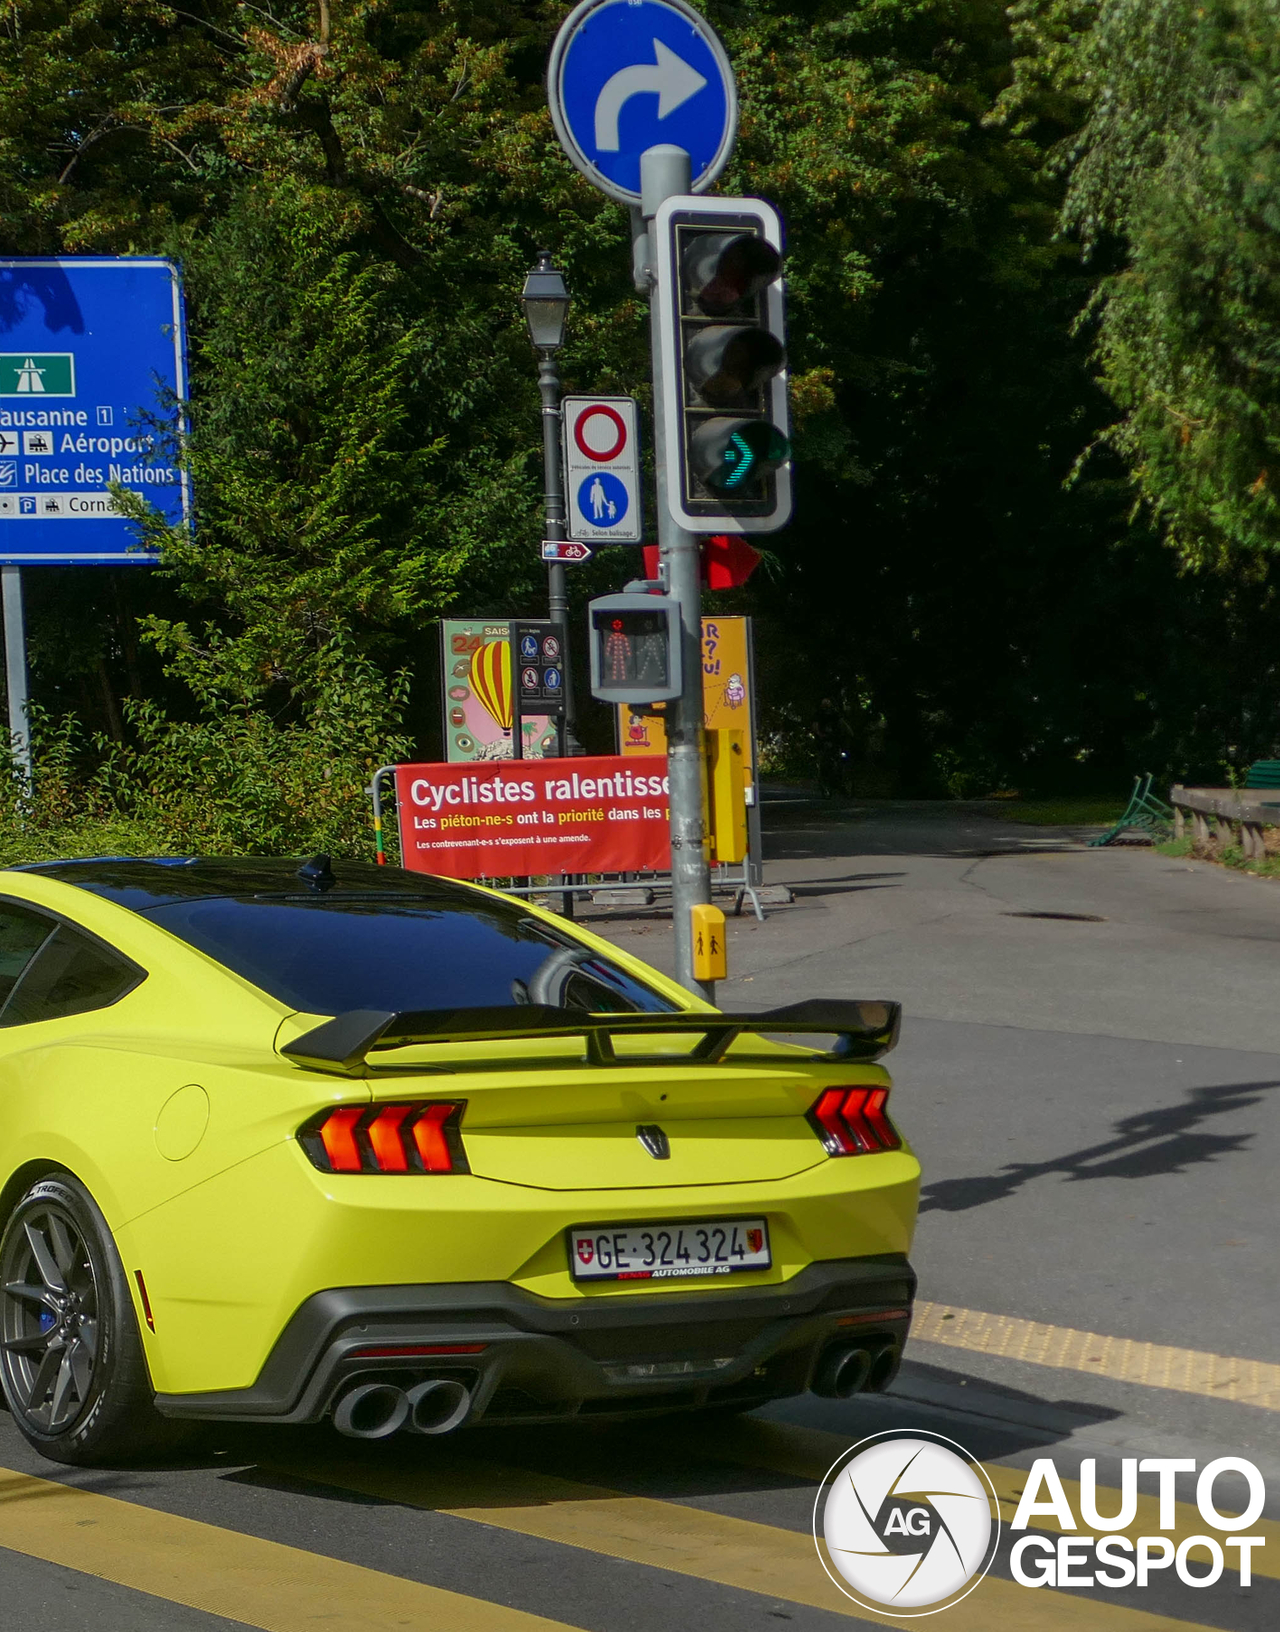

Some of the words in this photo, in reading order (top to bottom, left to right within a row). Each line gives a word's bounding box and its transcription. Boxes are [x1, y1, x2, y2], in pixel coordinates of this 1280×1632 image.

[60, 432, 155, 458] Aéroport
[24, 463, 69, 484] Place
[74, 462, 103, 483] des
[108, 462, 174, 484] Nations
[69, 497, 120, 512] Corna
[484, 627, 509, 636] SAIS
[452, 636, 481, 653] 24
[410, 776, 536, 812] Cyclistes
[413, 816, 437, 829] Les
[440, 814, 513, 831] piéton-ne-s
[516, 811, 539, 824] ont
[542, 810, 555, 823] la
[558, 808, 605, 825] priorité
[608, 807, 639, 820] dans
[643, 806, 662, 819] les
[416, 841, 430, 849] Les
[431, 838, 494, 849] contrevenant-e-s
[495, 836, 535, 847] s'exposent
[535, 835, 541, 844] à
[542, 836, 558, 844] une
[558, 834, 591, 843] amende.
[36, 1184, 74, 1203] TROFEO
[651, 1266, 715, 1278] AUTOMOBILE
[715, 1265, 731, 1274] AG
